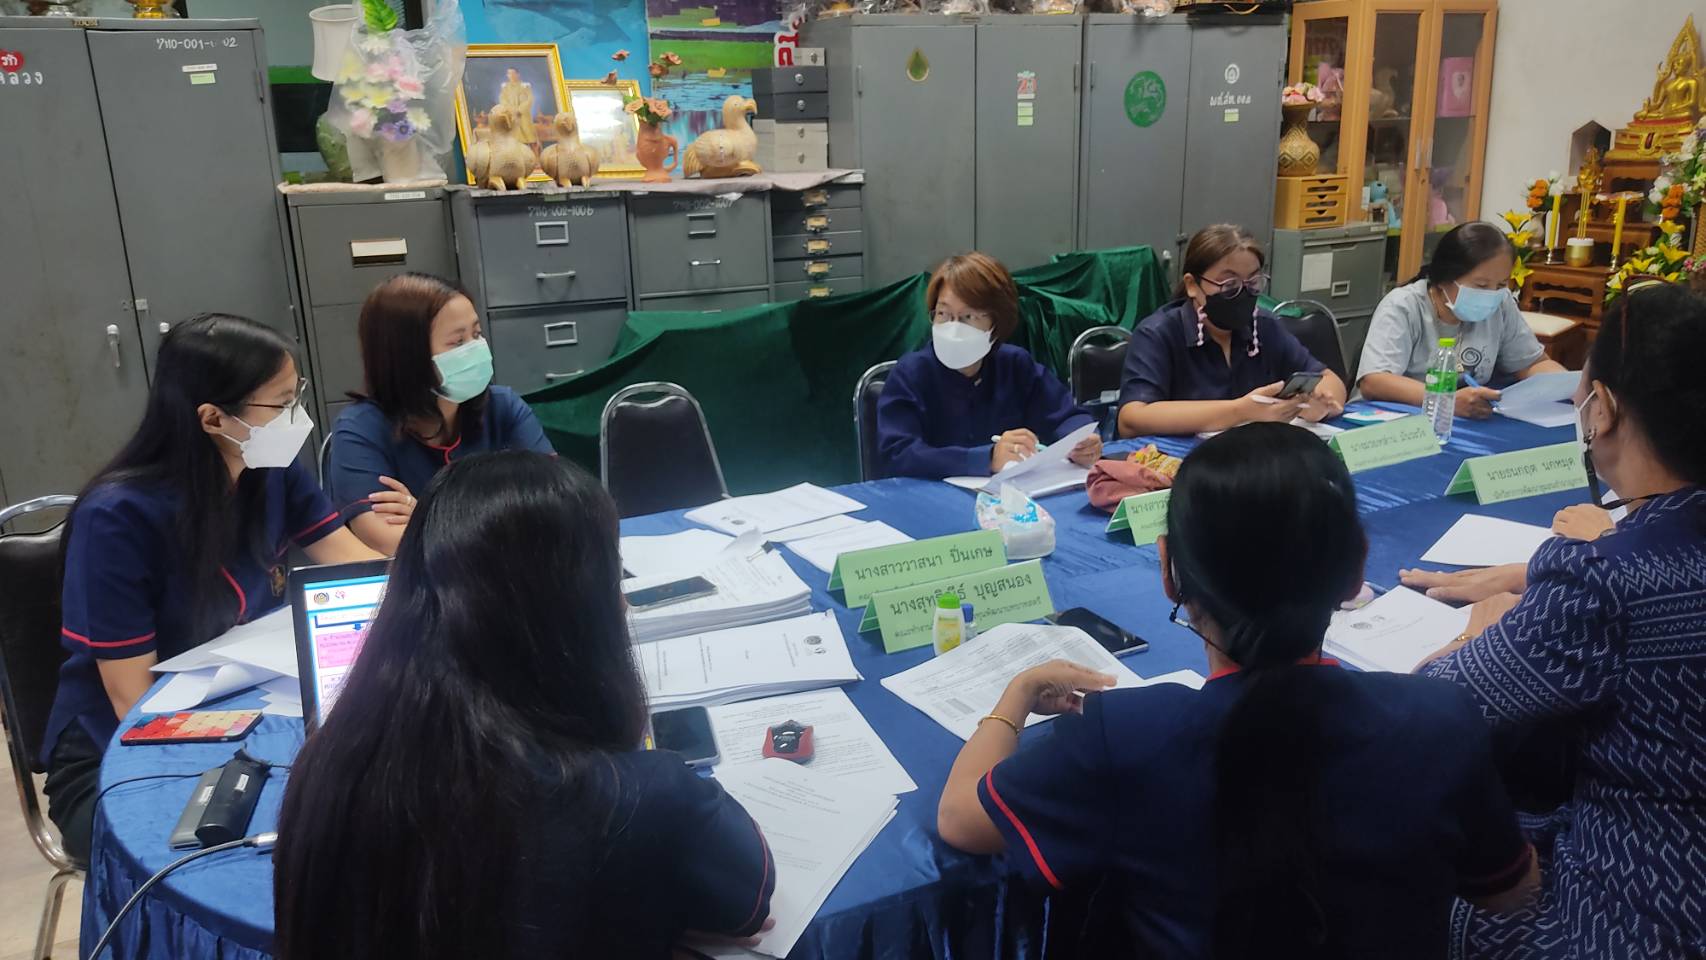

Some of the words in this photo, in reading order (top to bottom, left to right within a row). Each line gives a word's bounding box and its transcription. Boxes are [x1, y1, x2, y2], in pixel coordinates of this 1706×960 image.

[855, 554, 943, 581] นางสาววาสนา
[974, 573, 1033, 598] บุญสนอง
